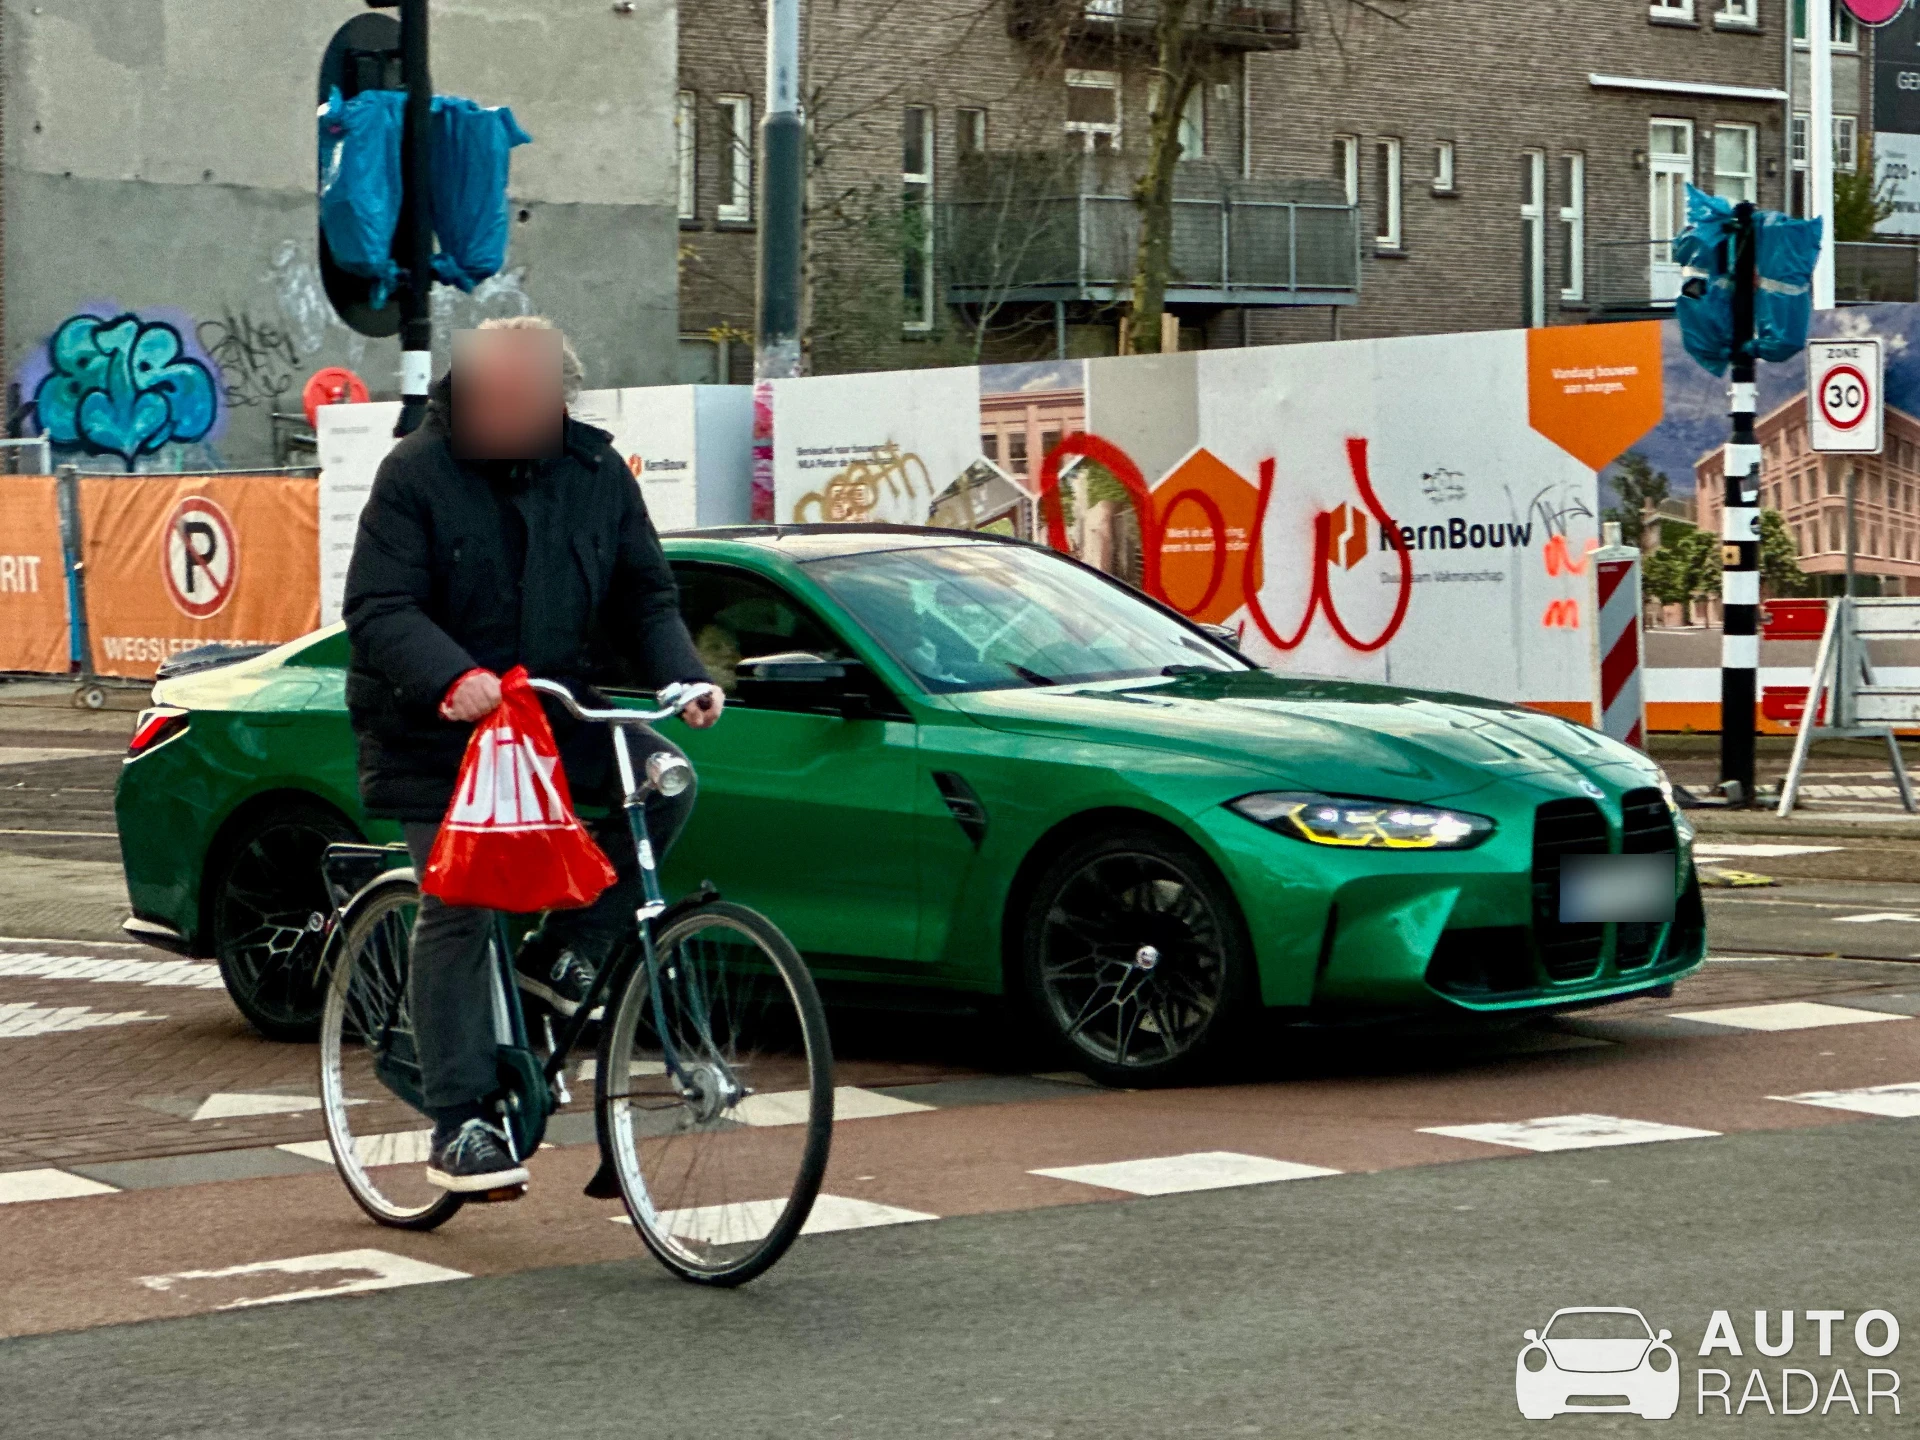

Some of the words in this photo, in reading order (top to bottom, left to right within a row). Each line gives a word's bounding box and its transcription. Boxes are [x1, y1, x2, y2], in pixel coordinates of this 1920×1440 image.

[1828, 348, 1860, 359] ZONE
[1551, 367, 1595, 380] Vandaag
[1596, 365, 1639, 377] bouwen
[1563, 384, 1583, 395] aan
[1828, 385, 1861, 408] 30
[1380, 517, 1534, 551] KernBouw
[183, 521, 217, 594] P
